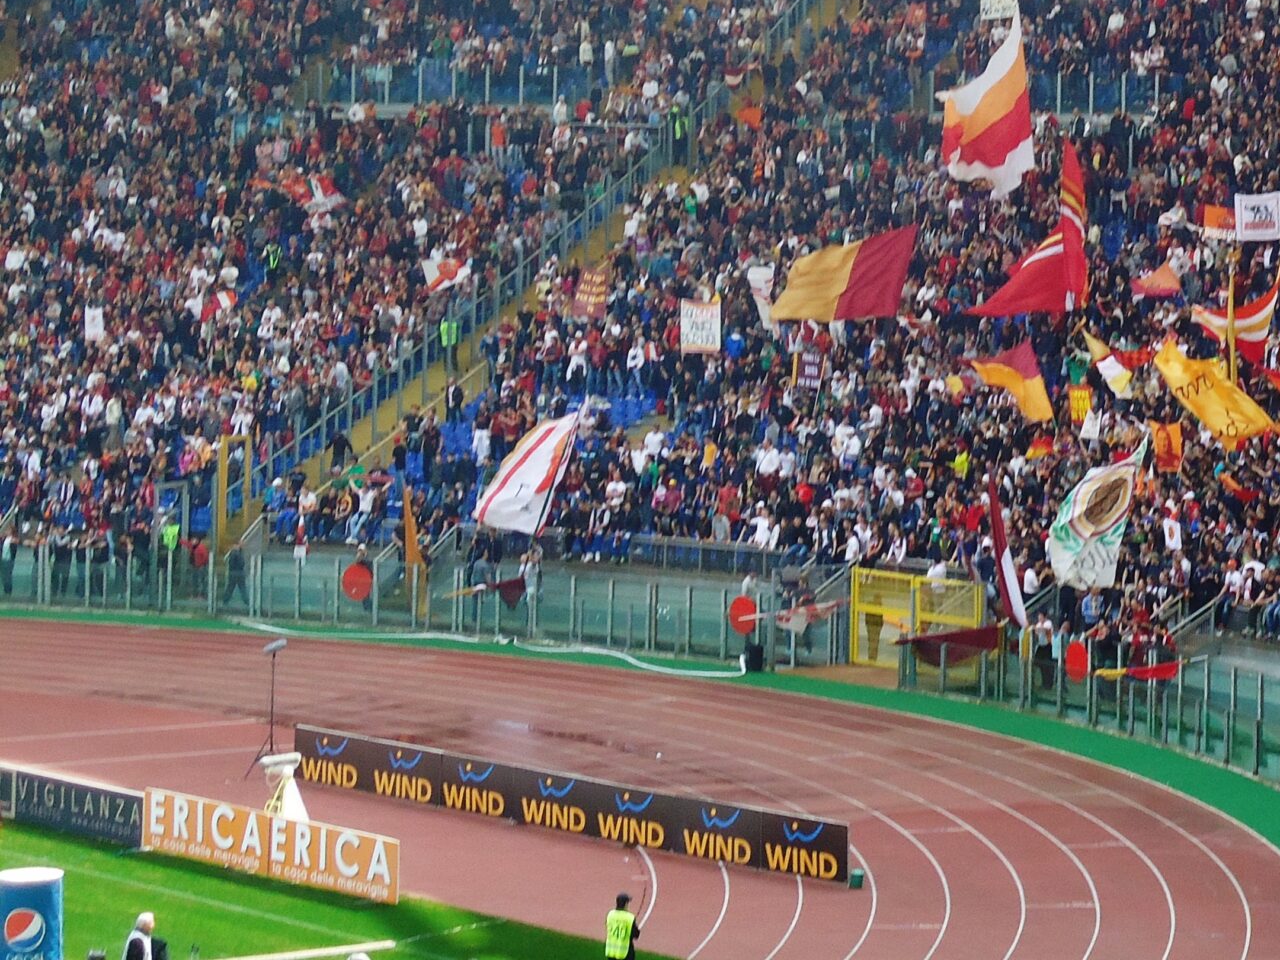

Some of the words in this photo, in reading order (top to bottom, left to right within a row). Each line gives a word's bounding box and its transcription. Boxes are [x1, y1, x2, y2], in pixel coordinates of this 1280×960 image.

[301, 756, 358, 789] WIND
[373, 769, 433, 804] WIND
[18, 777, 140, 826] VIGILANZA
[443, 781, 505, 817] WIND
[521, 796, 586, 833] WIND
[150, 788, 262, 857] ERICA
[597, 812, 665, 848] WIND
[271, 818, 391, 886] ERICA
[683, 828, 752, 865] WIND
[765, 842, 839, 880] WIND
